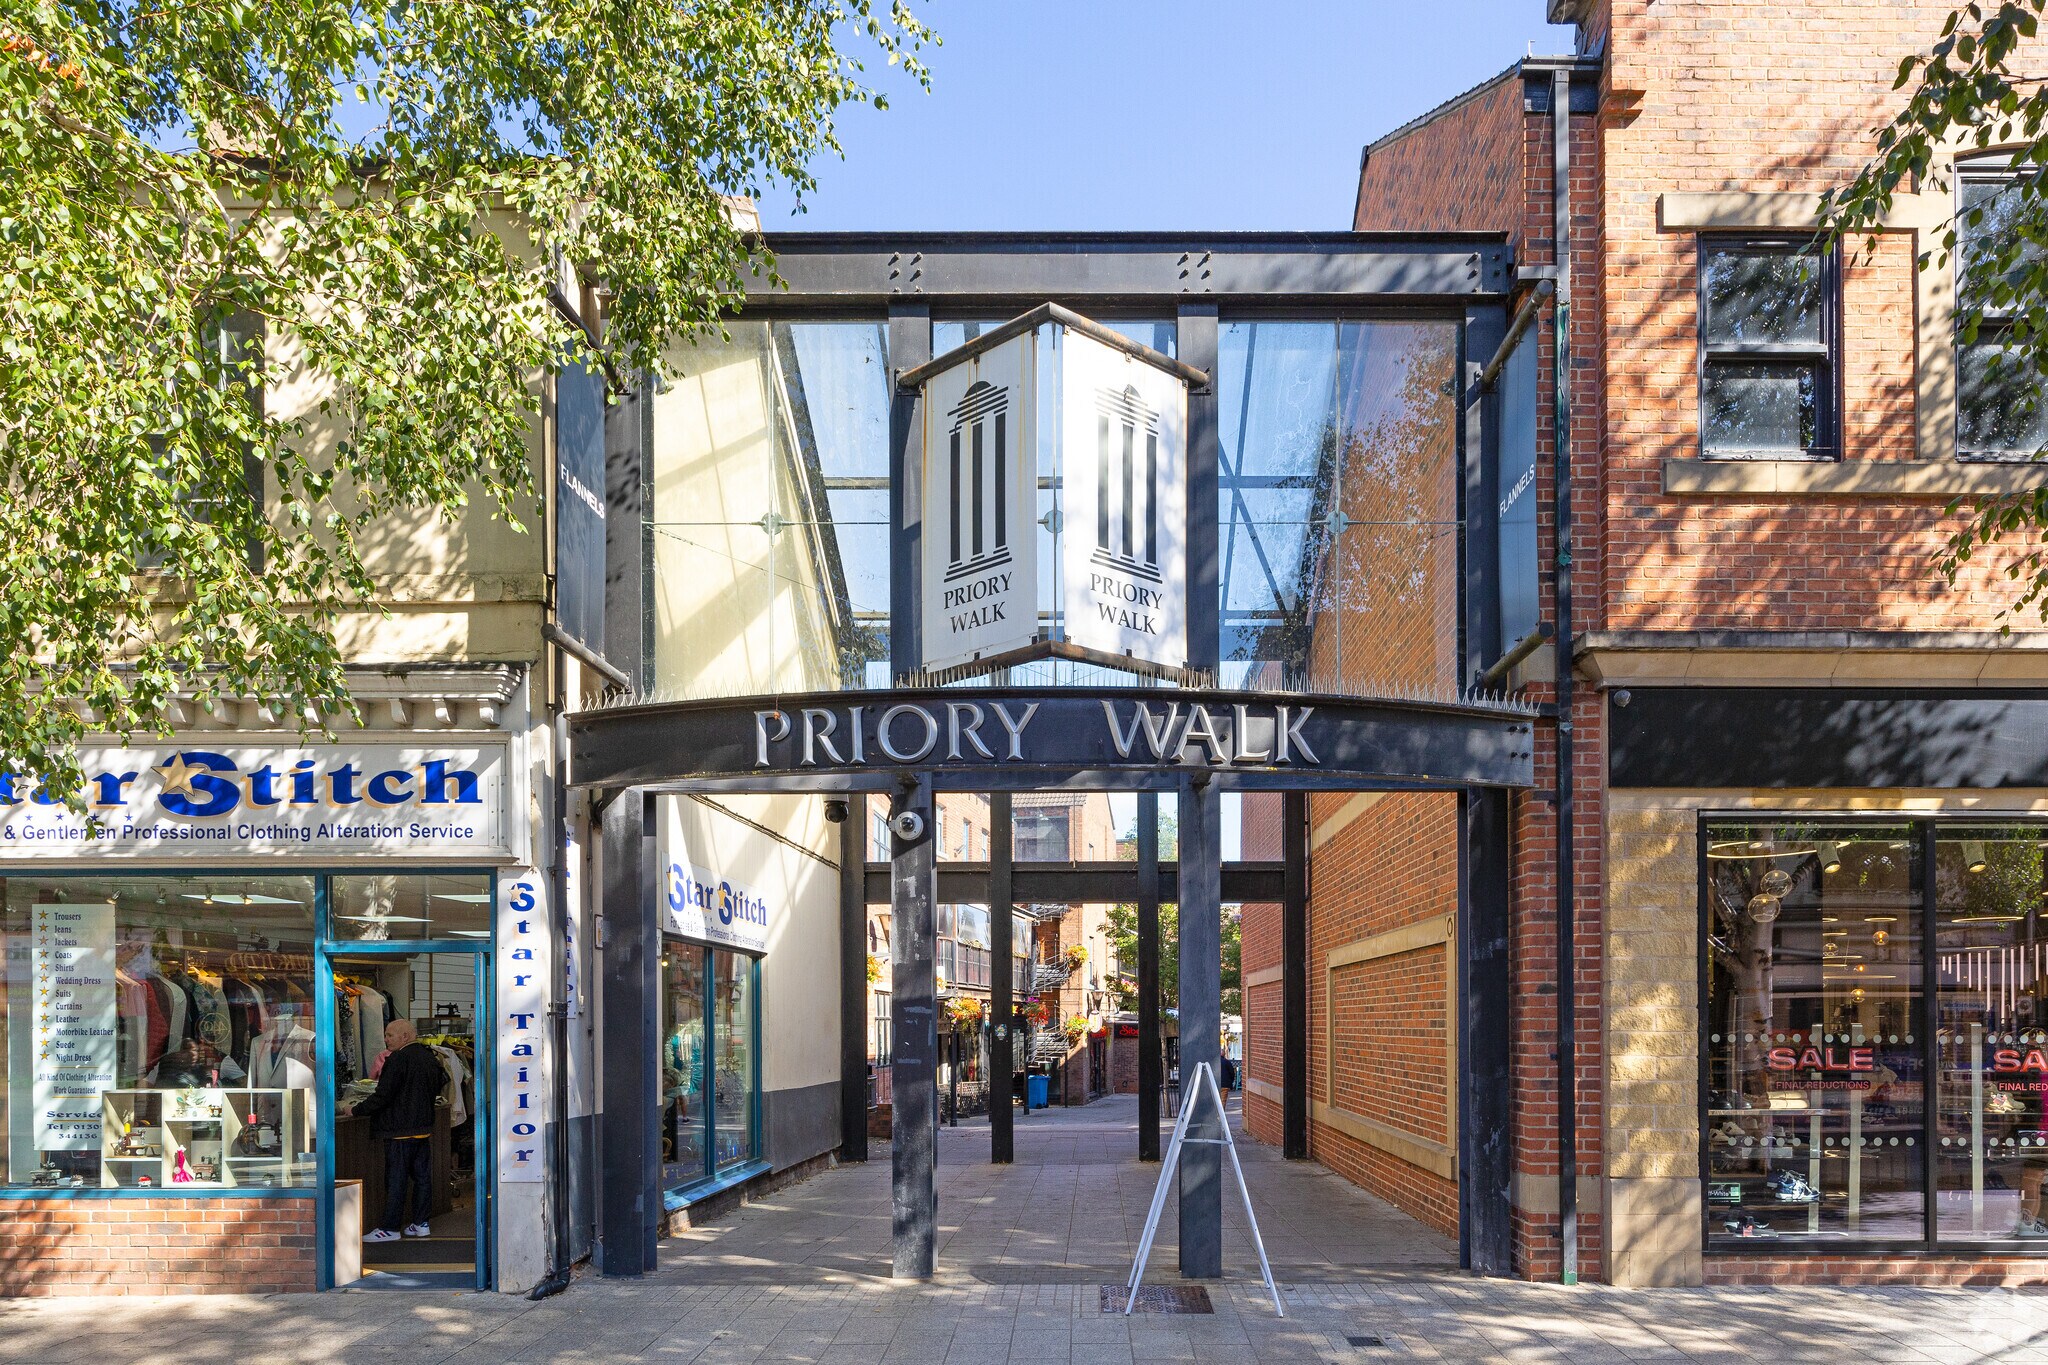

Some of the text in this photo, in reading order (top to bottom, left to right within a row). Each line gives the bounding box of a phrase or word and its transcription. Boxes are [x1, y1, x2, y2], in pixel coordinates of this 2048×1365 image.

[561, 463, 605, 519] FLANNELS
[1500, 463, 1535, 518] FLANNELS
[943, 571, 1012, 610] PRIORY
[1090, 572, 1163, 611] PRIORY
[950, 601, 1006, 634] WALK
[1097, 601, 1157, 636] WALK
[754, 700, 1320, 767] PRIORY WALK
[154, 751, 483, 817] Stitch
[4, 825, 16, 840] &
[122, 823, 231, 840] Professional
[237, 823, 311, 843] Clothing
[316, 822, 403, 839] Alteration
[409, 822, 474, 839] Service
[667, 863, 767, 927] Star Stitch
[54, 912, 82, 921] Trousers
[54, 925, 72, 934] Jeans
[509, 882, 536, 987] Star
[54, 938, 77, 946] Jackets
[55, 951, 72, 959] Coats
[55, 964, 74, 972] Shirts
[55, 976, 102, 986] Wedding Dress
[55, 989, 72, 998] Suits
[55, 1002, 83, 1010] Curtains
[55, 1015, 80, 1023] Leather
[56, 1027, 114, 1036] Motorbike Leather
[55, 1041, 75, 1049] Suede
[56, 1053, 92, 1063] Night Dress
[1768, 1047, 1874, 1071] SALE
[66, 1073, 87, 1083] Clothing
[53, 1085, 96, 1094] Work Guaranteed
[509, 1013, 536, 1161] Tailor
[1776, 1081, 1869, 1090] FINAL REDUCTIONS
[1999, 1082, 2027, 1091] FINAL
